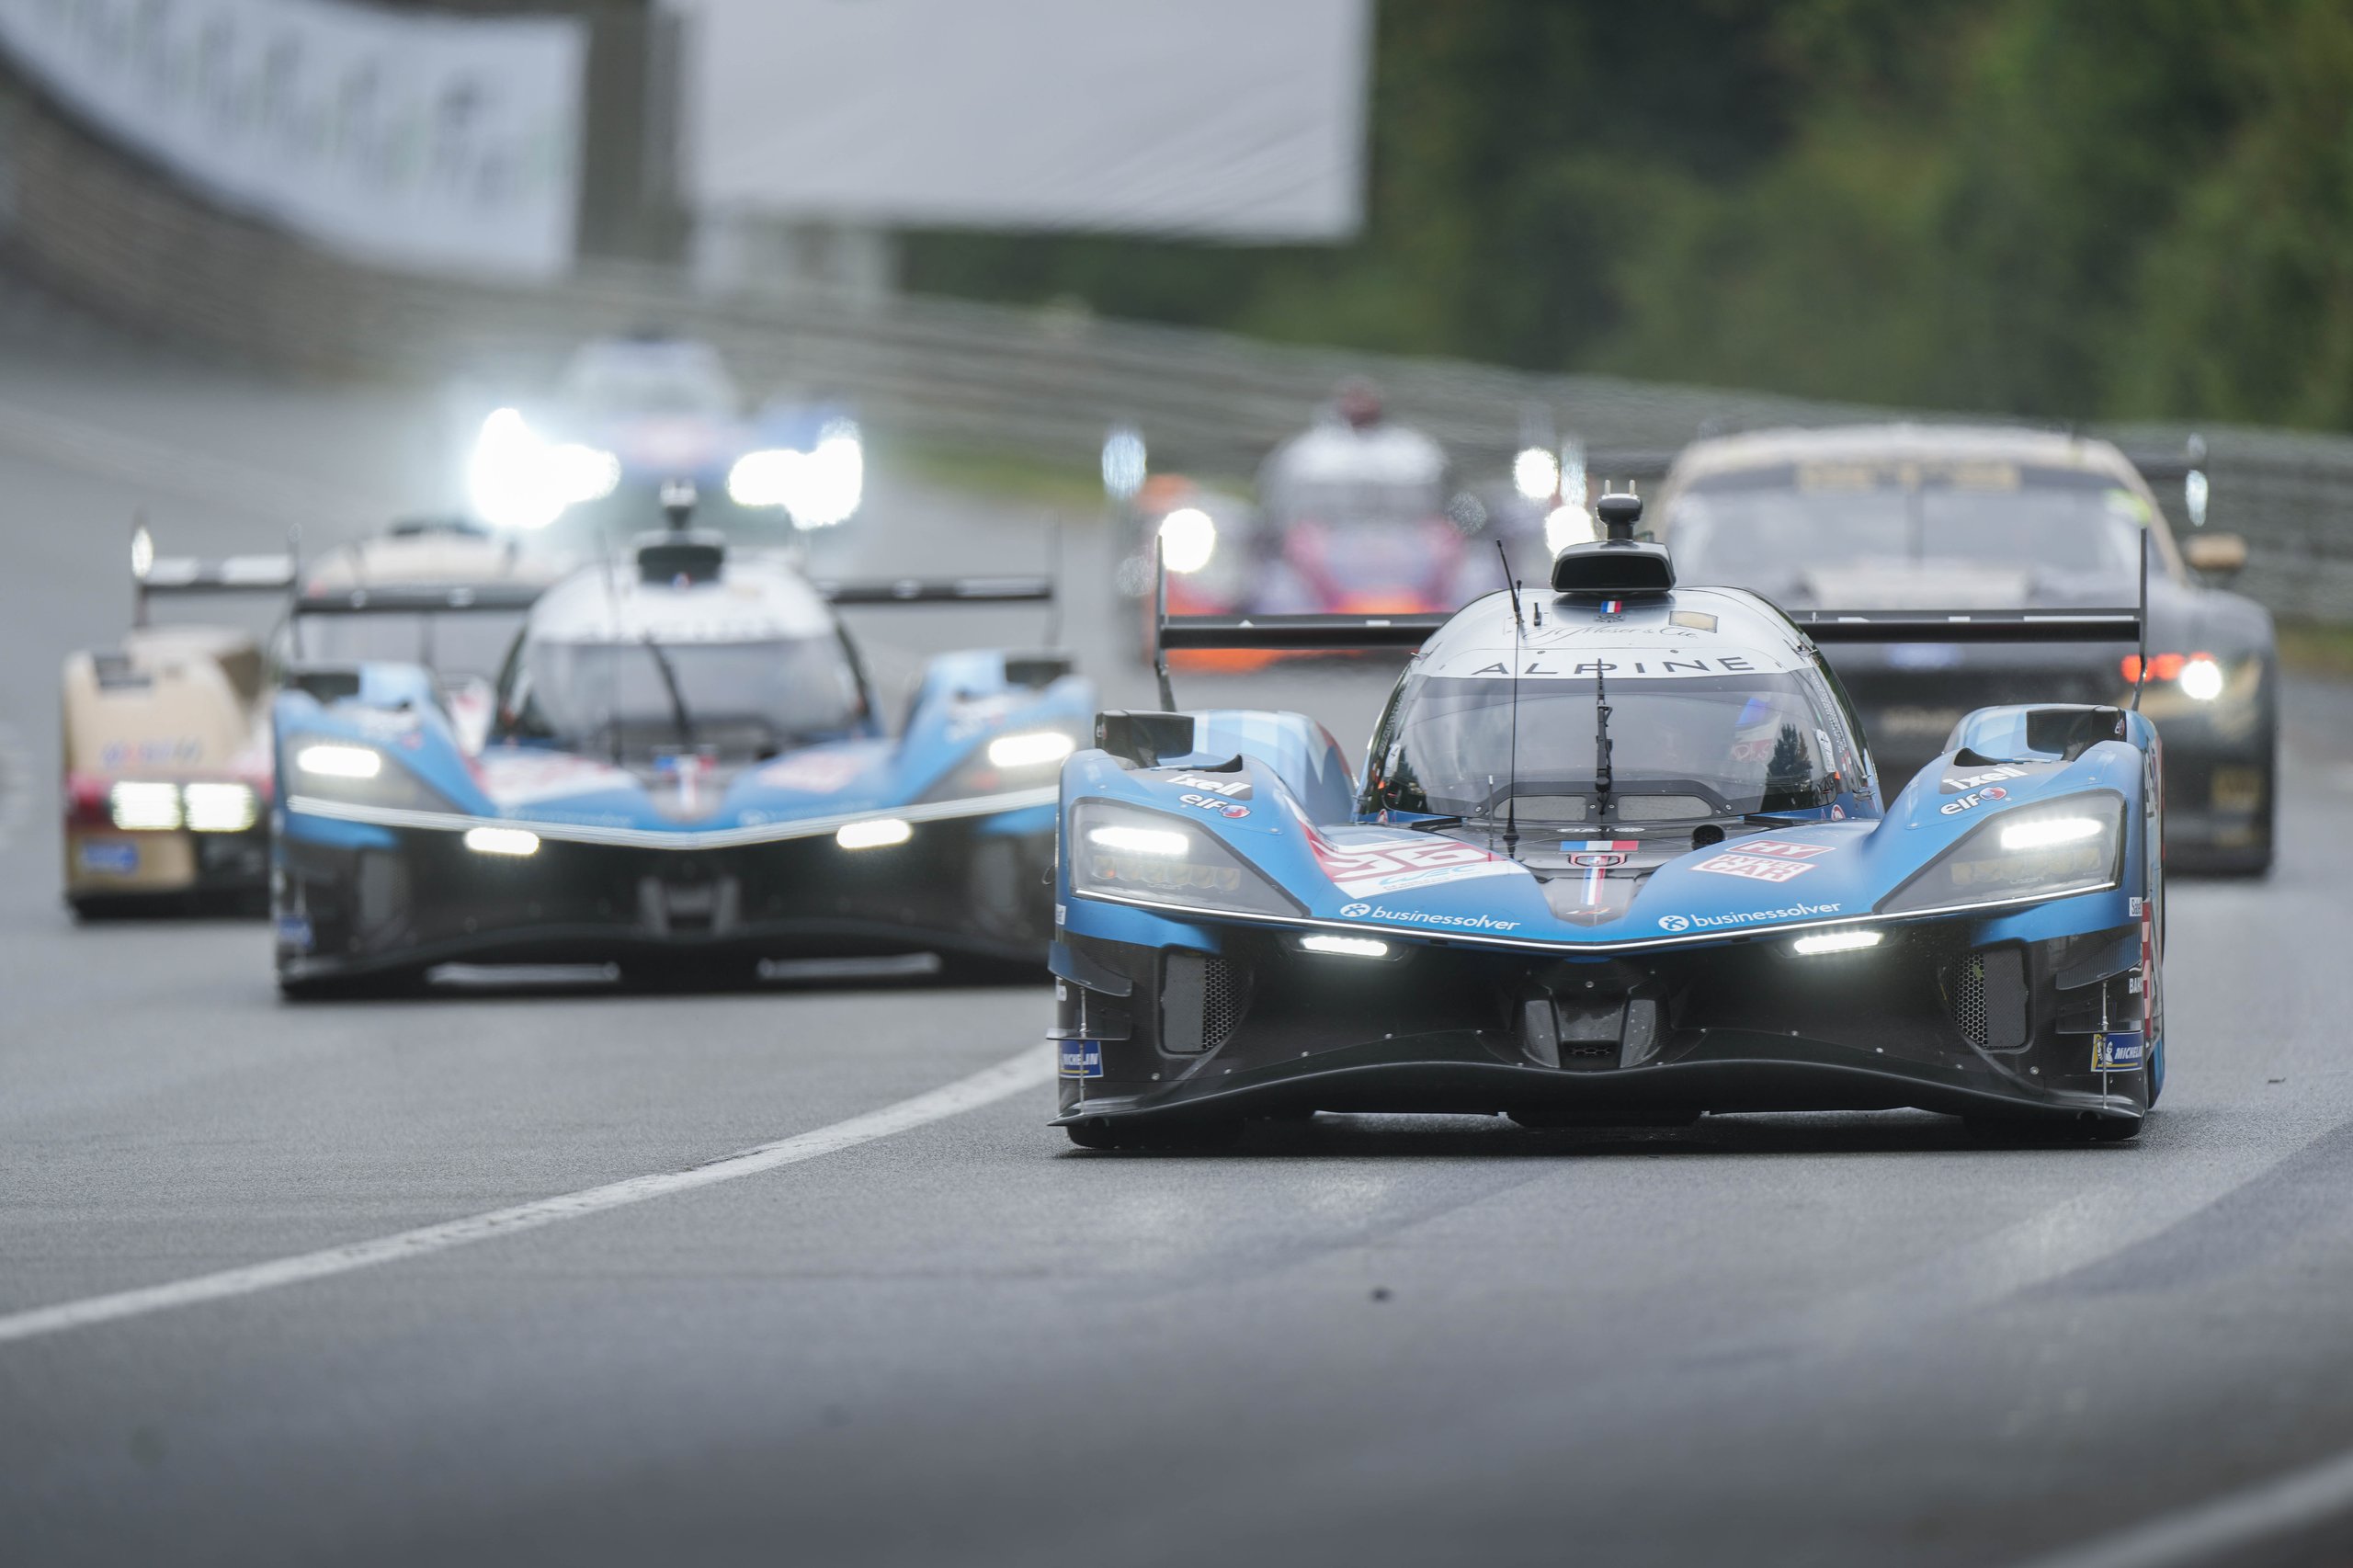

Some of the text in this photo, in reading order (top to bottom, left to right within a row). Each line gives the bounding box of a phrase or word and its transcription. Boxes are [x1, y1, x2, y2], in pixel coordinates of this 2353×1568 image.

[1471, 656, 1756, 676] ALPINE
[1165, 773, 1253, 796] ixell
[1941, 767, 2029, 790] ixell
[1178, 794, 1229, 810] elf
[1939, 793, 1980, 815] elf
[1738, 841, 1822, 859] HY
[1701, 860, 1793, 881] CAR
[1717, 855, 1803, 870] HYPER
[1371, 905, 1522, 931] businessolver
[1689, 902, 1842, 928] businessolver
